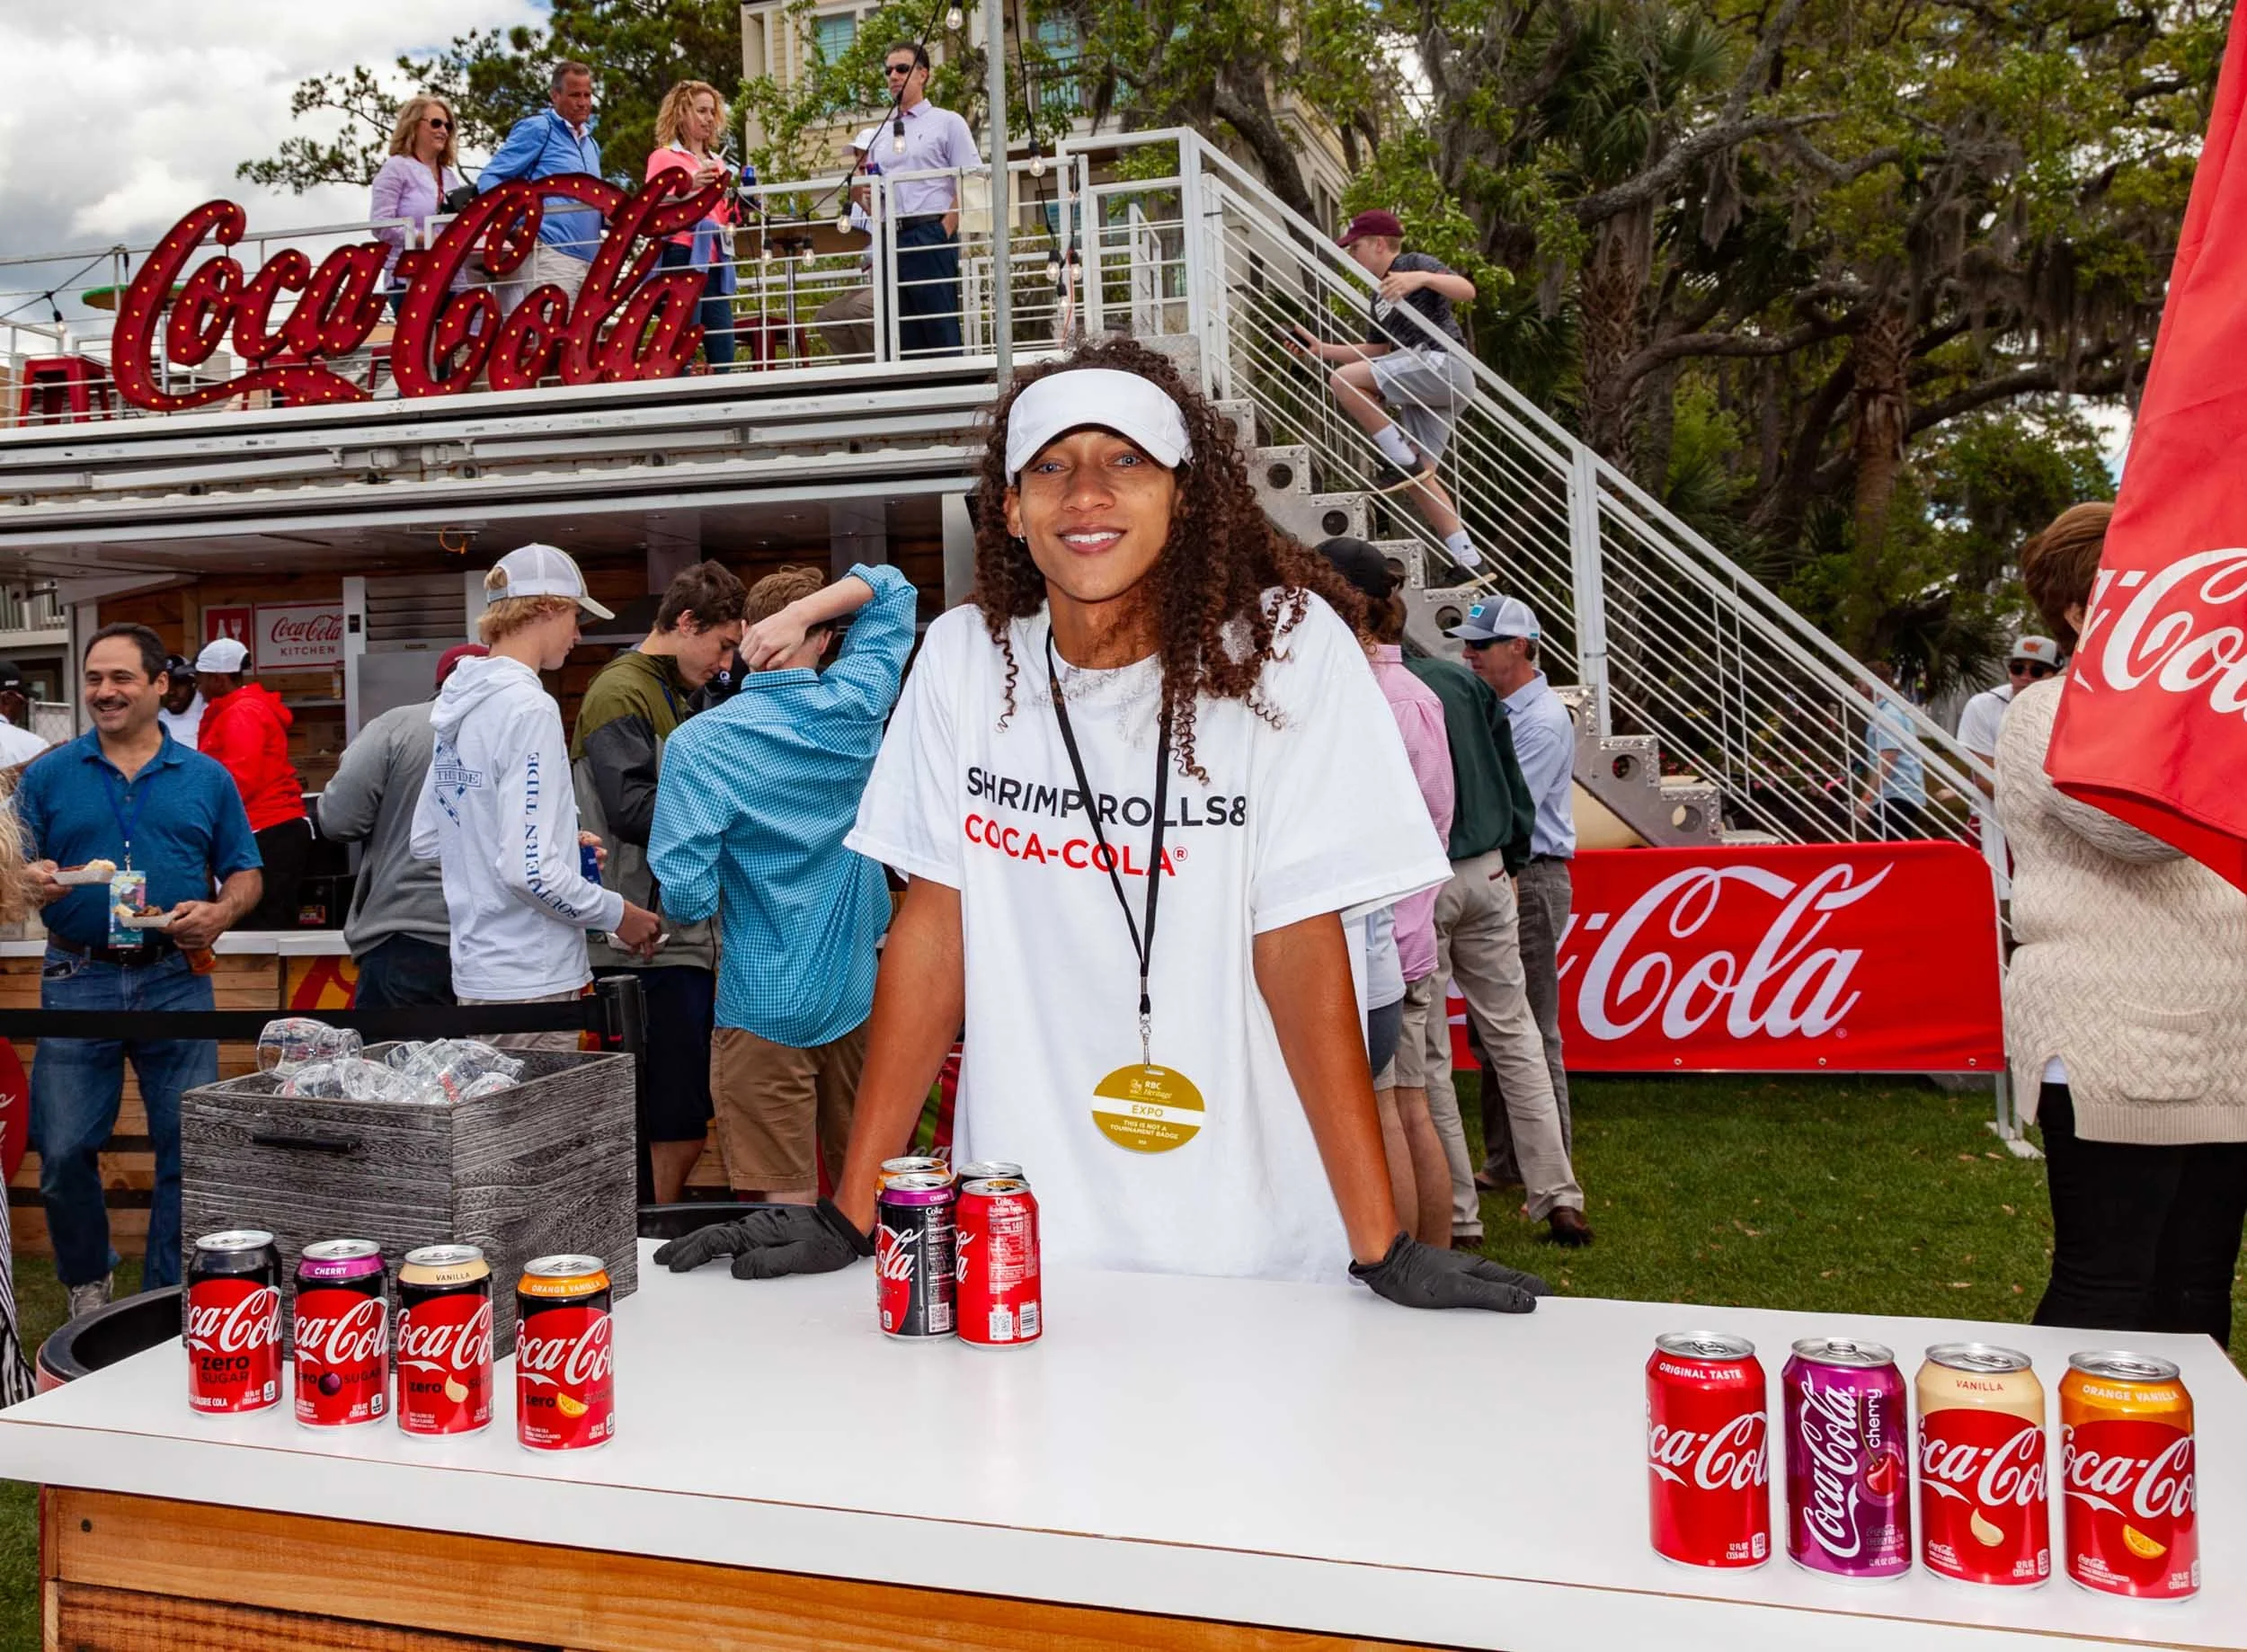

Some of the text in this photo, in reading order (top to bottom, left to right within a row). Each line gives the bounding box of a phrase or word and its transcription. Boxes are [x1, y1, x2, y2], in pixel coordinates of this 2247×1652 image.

[111, 165, 733, 412] Coca-Cola
[280, 646, 335, 656] KITCHEN
[525, 752, 539, 815] TIDE
[967, 767, 1085, 819] SHRIMP
[1132, 1105, 1164, 1117] EXPO
[1124, 1119, 1138, 1127] THIS
[1147, 1123, 1160, 1131] NOT
[1156, 1131, 1179, 1140] BADGE
[315, 1267, 347, 1275] CHERRY
[436, 1272, 471, 1282] VANILLA
[531, 1280, 601, 1294] ORANGE VANILLA
[201, 1355, 250, 1371] zero
[1659, 1362, 1743, 1380] ORIGINAL TASTE
[201, 1372, 249, 1384] SUGAR
[409, 1381, 442, 1393] zero
[1956, 1380, 2004, 1391] VANILLA
[2082, 1384, 2180, 1402] ORANGE VANILLA
[526, 1395, 555, 1408] zero
[1865, 1389, 1883, 1449] cherry
[1800, 1369, 1861, 1559] Coca-Cola
